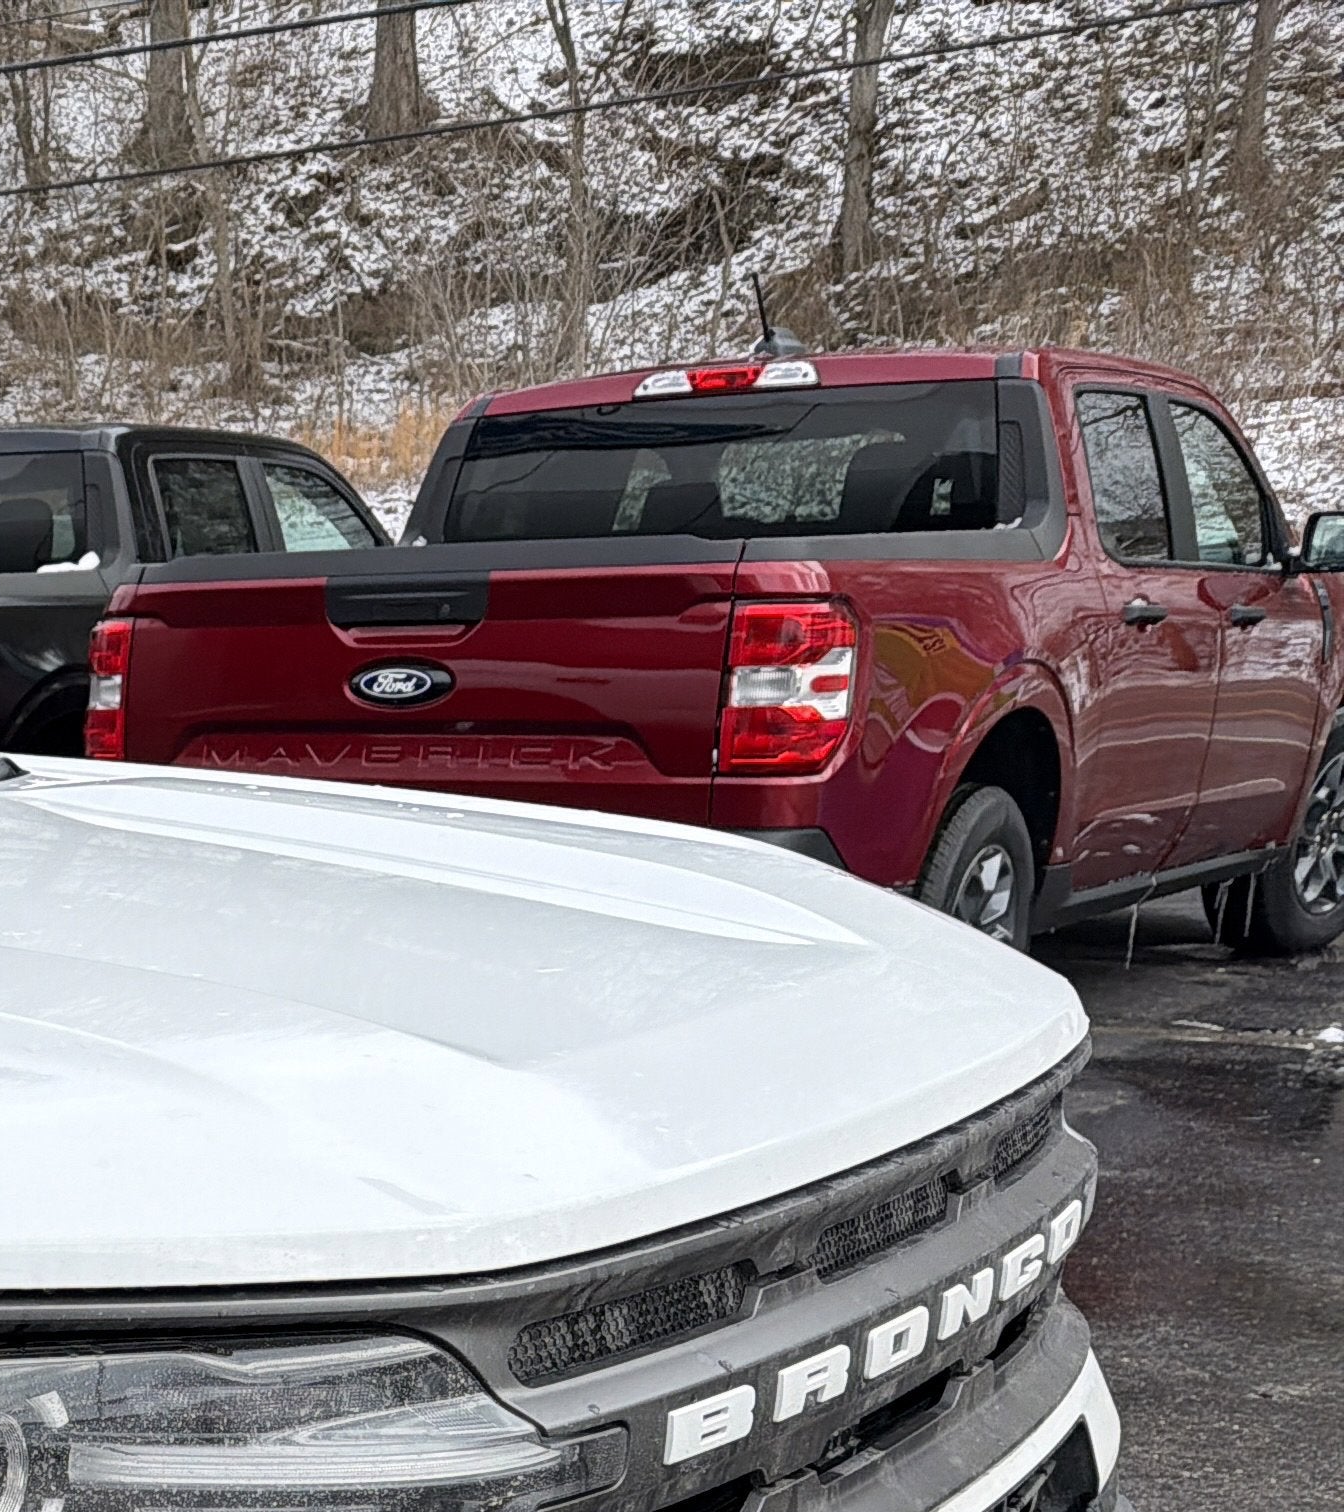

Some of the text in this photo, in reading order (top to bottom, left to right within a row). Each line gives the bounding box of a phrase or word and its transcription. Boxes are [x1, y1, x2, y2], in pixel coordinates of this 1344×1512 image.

[372, 673, 417, 693] Ford
[201, 741, 616, 771] MAVERICK
[664, 1200, 1084, 1466] BRONCO
